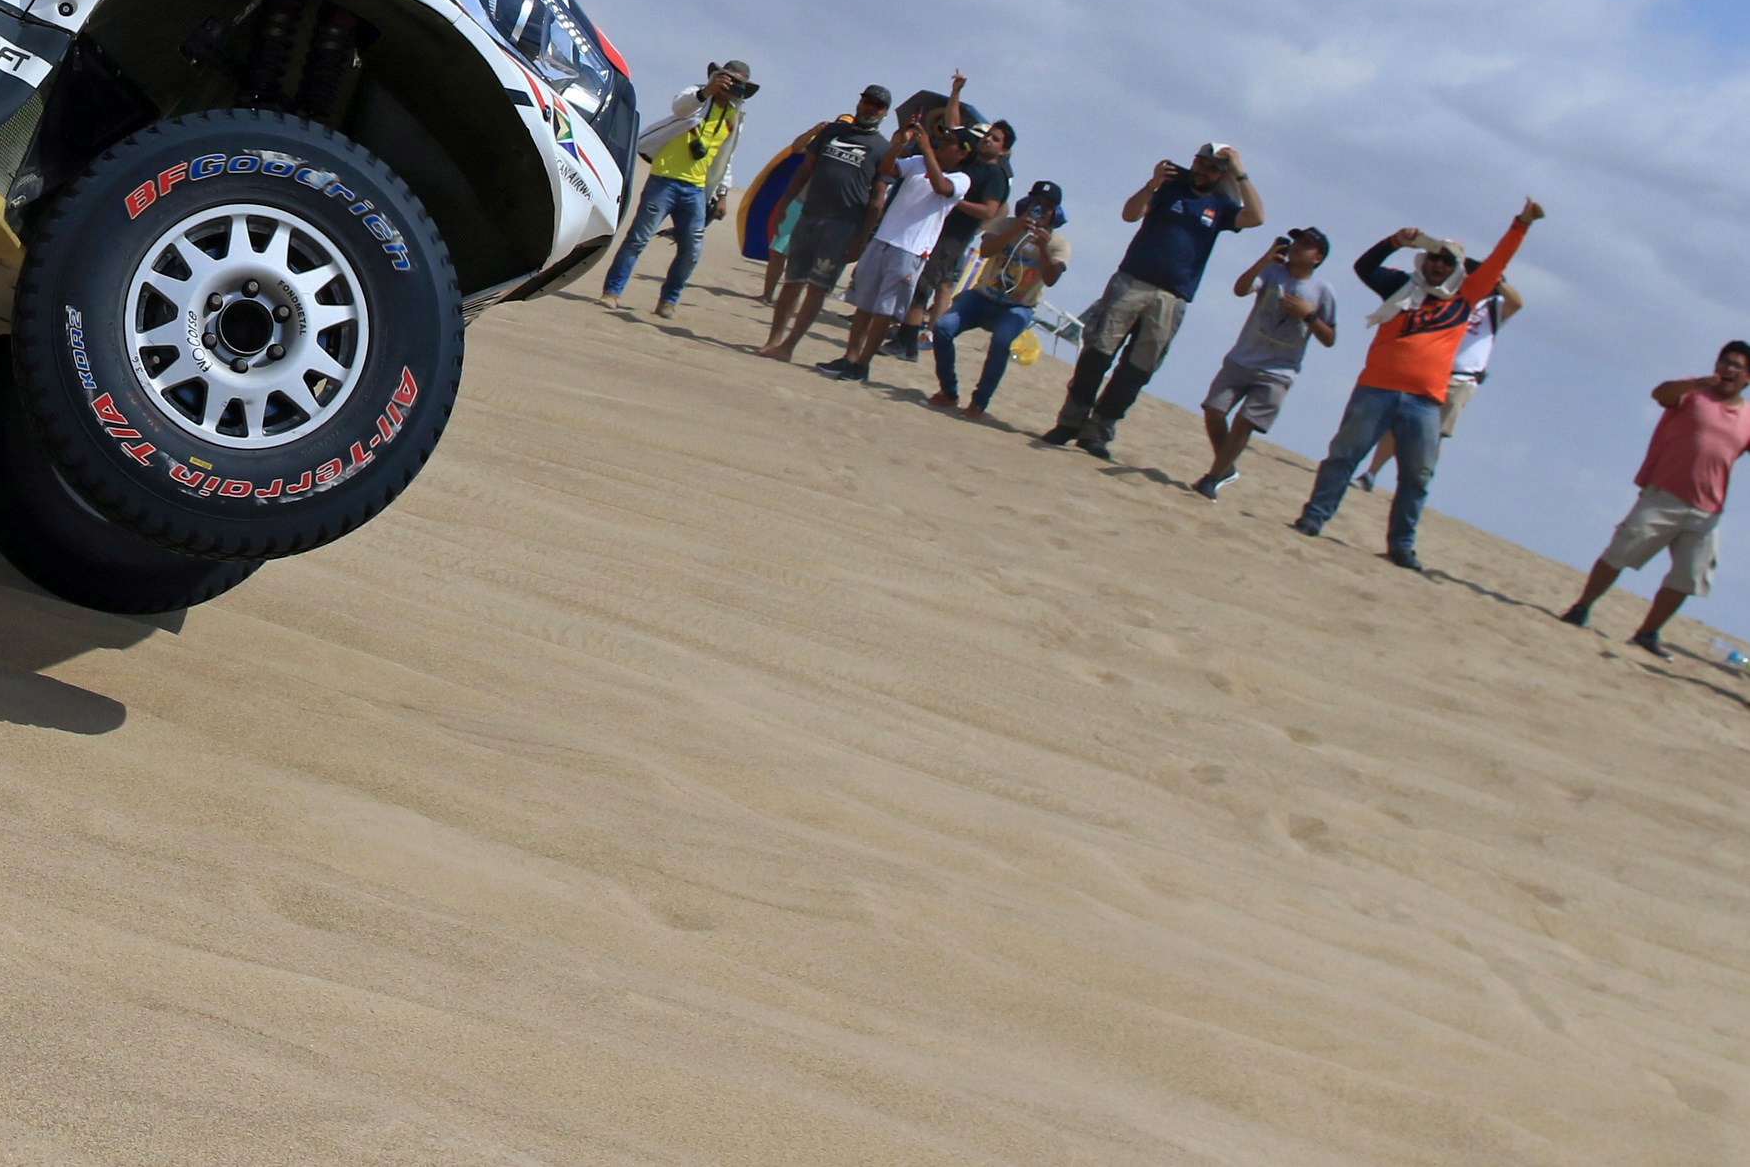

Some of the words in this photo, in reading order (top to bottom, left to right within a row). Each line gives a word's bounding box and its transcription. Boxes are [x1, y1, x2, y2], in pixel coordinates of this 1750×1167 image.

[123, 152, 414, 272] BFGoodrich
[278, 280, 307, 336] FONDMETAL
[91, 392, 157, 468] T/A
[169, 365, 419, 499] All-Terrain
